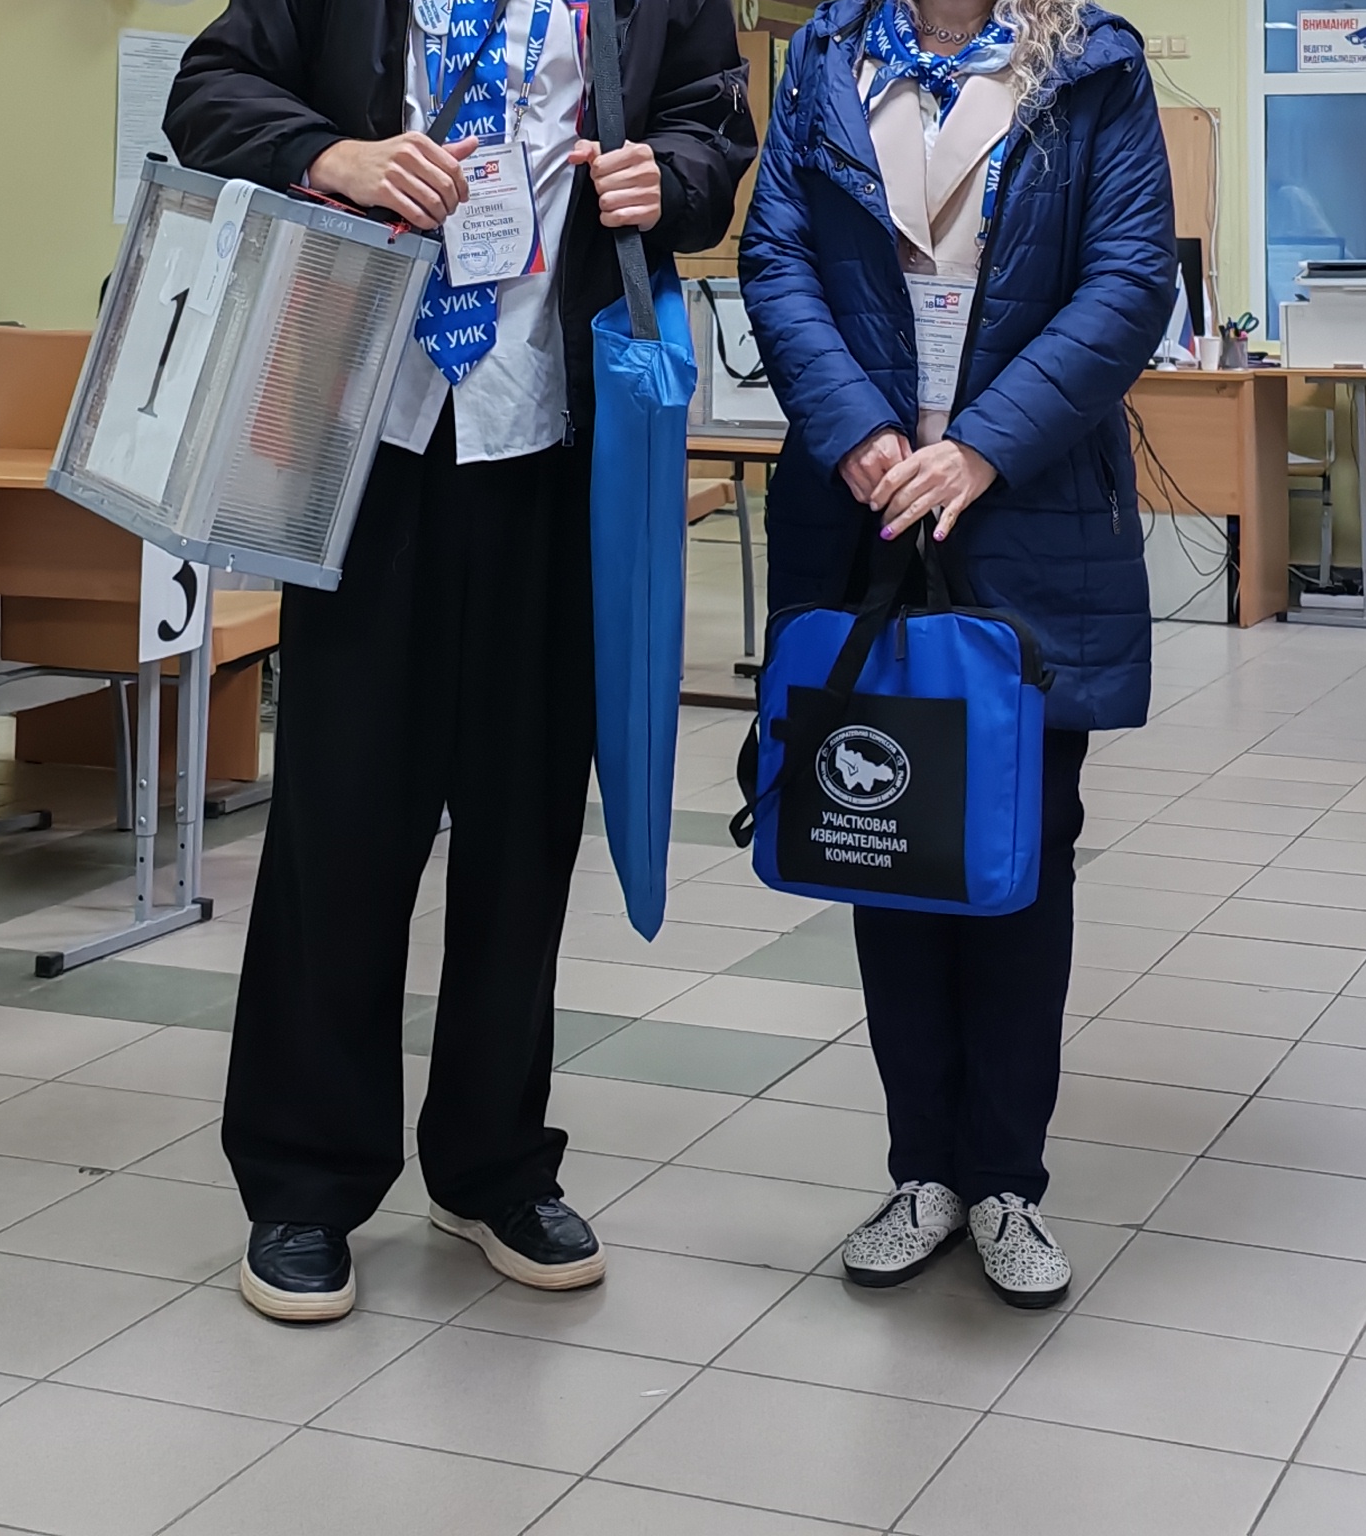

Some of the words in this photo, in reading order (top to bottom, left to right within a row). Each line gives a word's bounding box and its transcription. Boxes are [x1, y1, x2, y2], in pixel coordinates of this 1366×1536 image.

[451, 19, 478, 38] ИК
[1302, 19, 1359, 31] ВНИМАНИЕ!
[426, 34, 441, 56] ИК
[876, 21, 892, 58] УИК
[1303, 44, 1332, 53] ВЕДЕТСЯ
[526, 36, 544, 71] УИК
[464, 82, 492, 104] ИК
[455, 115, 498, 140] УИК
[485, 162, 498, 173] 20
[986, 159, 1002, 193] УИК
[465, 202, 504, 216] Литвин
[462, 216, 514, 230] Святослав
[462, 227, 520, 242] Валерьевич
[439, 290, 482, 315] УИК
[925, 300, 934, 309] 18
[935, 296, 946, 307] 19
[946, 294, 958, 305] 20
[445, 323, 488, 348] УИК
[137, 287, 190, 418] 1
[822, 811, 897, 834] УЧАСТКОВАЯ
[810, 827, 908, 853] ИЗБИРАТЕЛЬНАЯ
[825, 847, 892, 869] КОМИССИЯ
